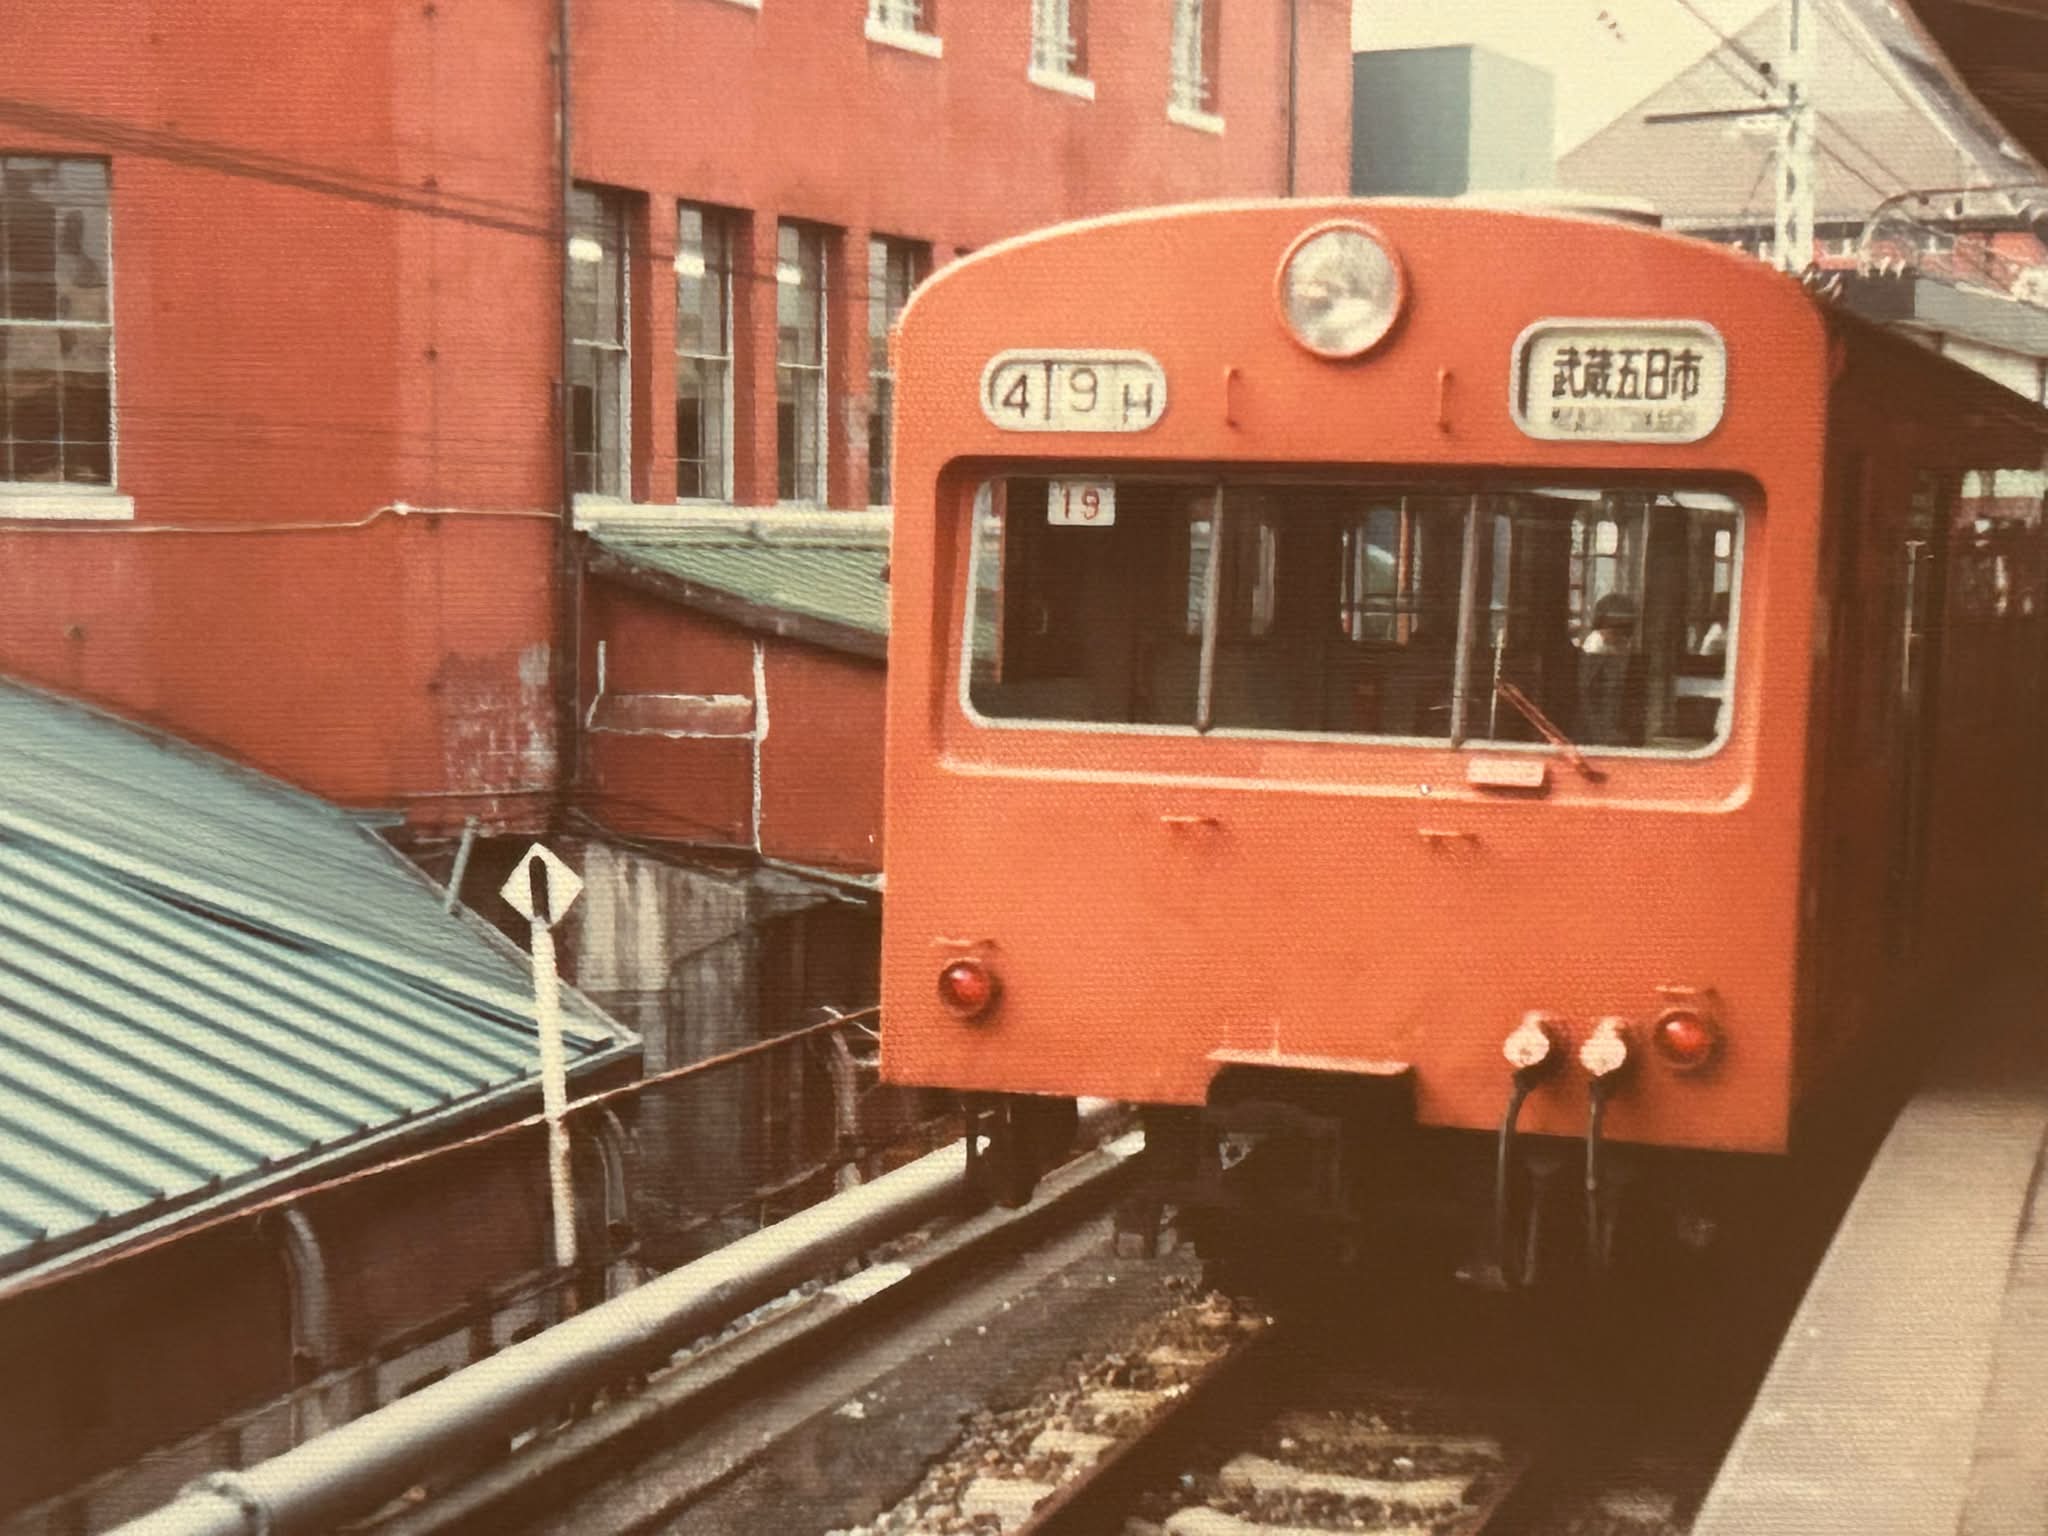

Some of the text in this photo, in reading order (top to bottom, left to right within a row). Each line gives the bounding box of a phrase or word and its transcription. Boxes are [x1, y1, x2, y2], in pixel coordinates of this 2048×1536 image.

[1552, 346, 1703, 401] 武蔵五日市
[1062, 487, 1100, 519] 19
